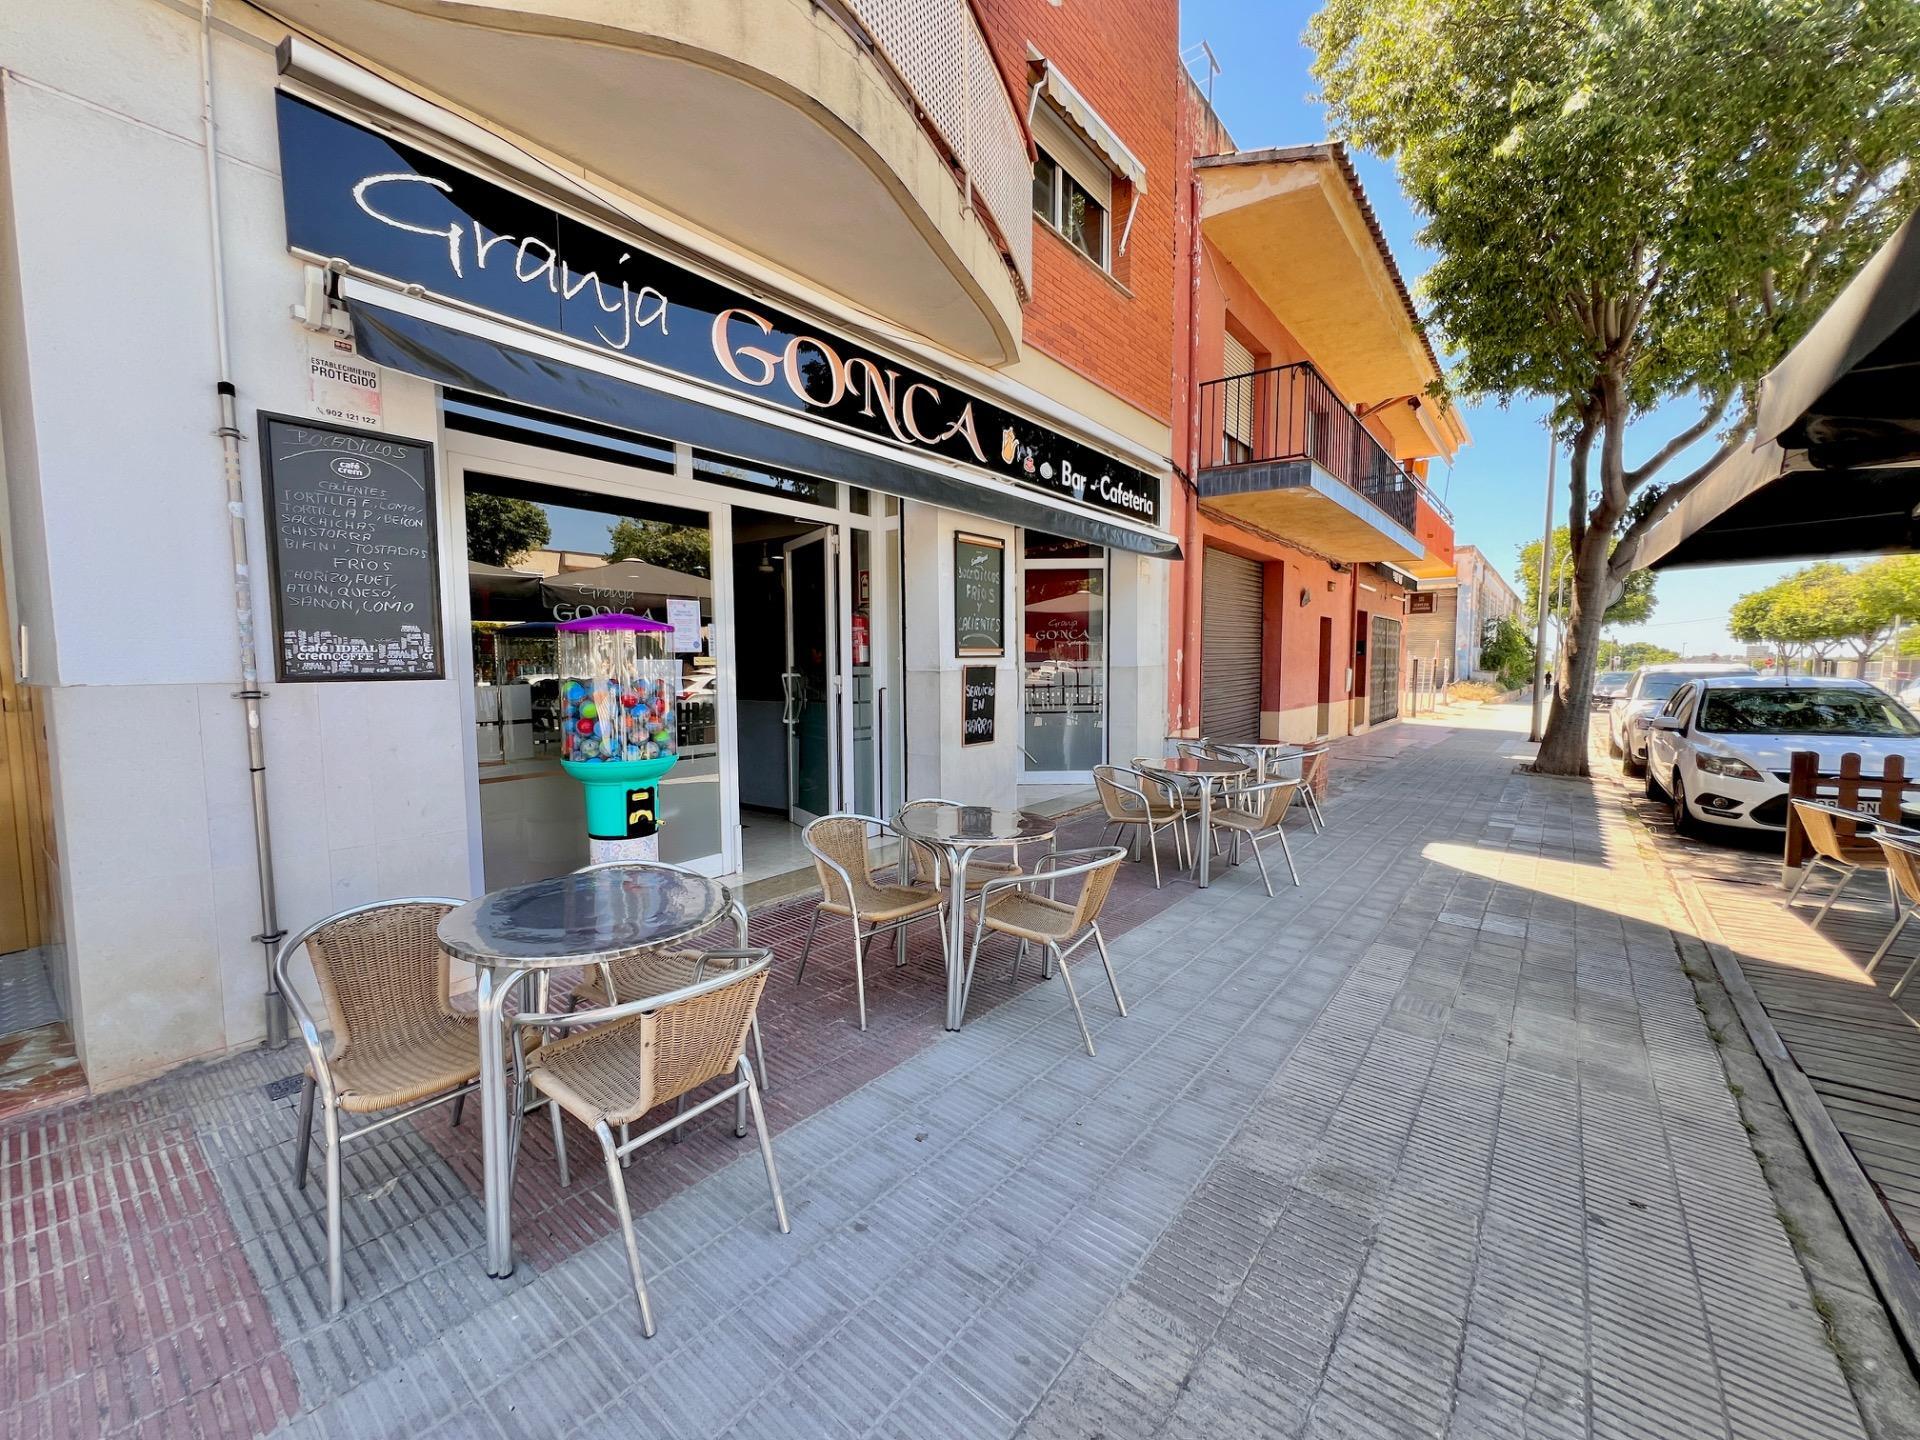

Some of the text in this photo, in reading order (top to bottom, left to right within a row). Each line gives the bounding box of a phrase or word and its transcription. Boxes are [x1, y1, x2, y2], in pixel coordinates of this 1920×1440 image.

[352, 173, 669, 350] Granja
[711, 308, 988, 463] GONCA
[1061, 460, 1087, 490] Bar
[1100, 475, 1154, 516] Cafeteria
[310, 357, 376, 379] ESTABLECIMIENTO
[311, 365, 377, 389] PROTEGIDO
[325, 408, 377, 425] 902 121 122
[337, 467, 363, 477] crem
[339, 461, 361, 471] café
[281, 525, 372, 542] CHISTORRA
[579, 584, 635, 605] Granja
[1035, 629, 1091, 642] GONCA
[299, 643, 378, 653] café IDEAL
[297, 652, 374, 661] crem COFFE
[971, 698, 985, 711] EN
